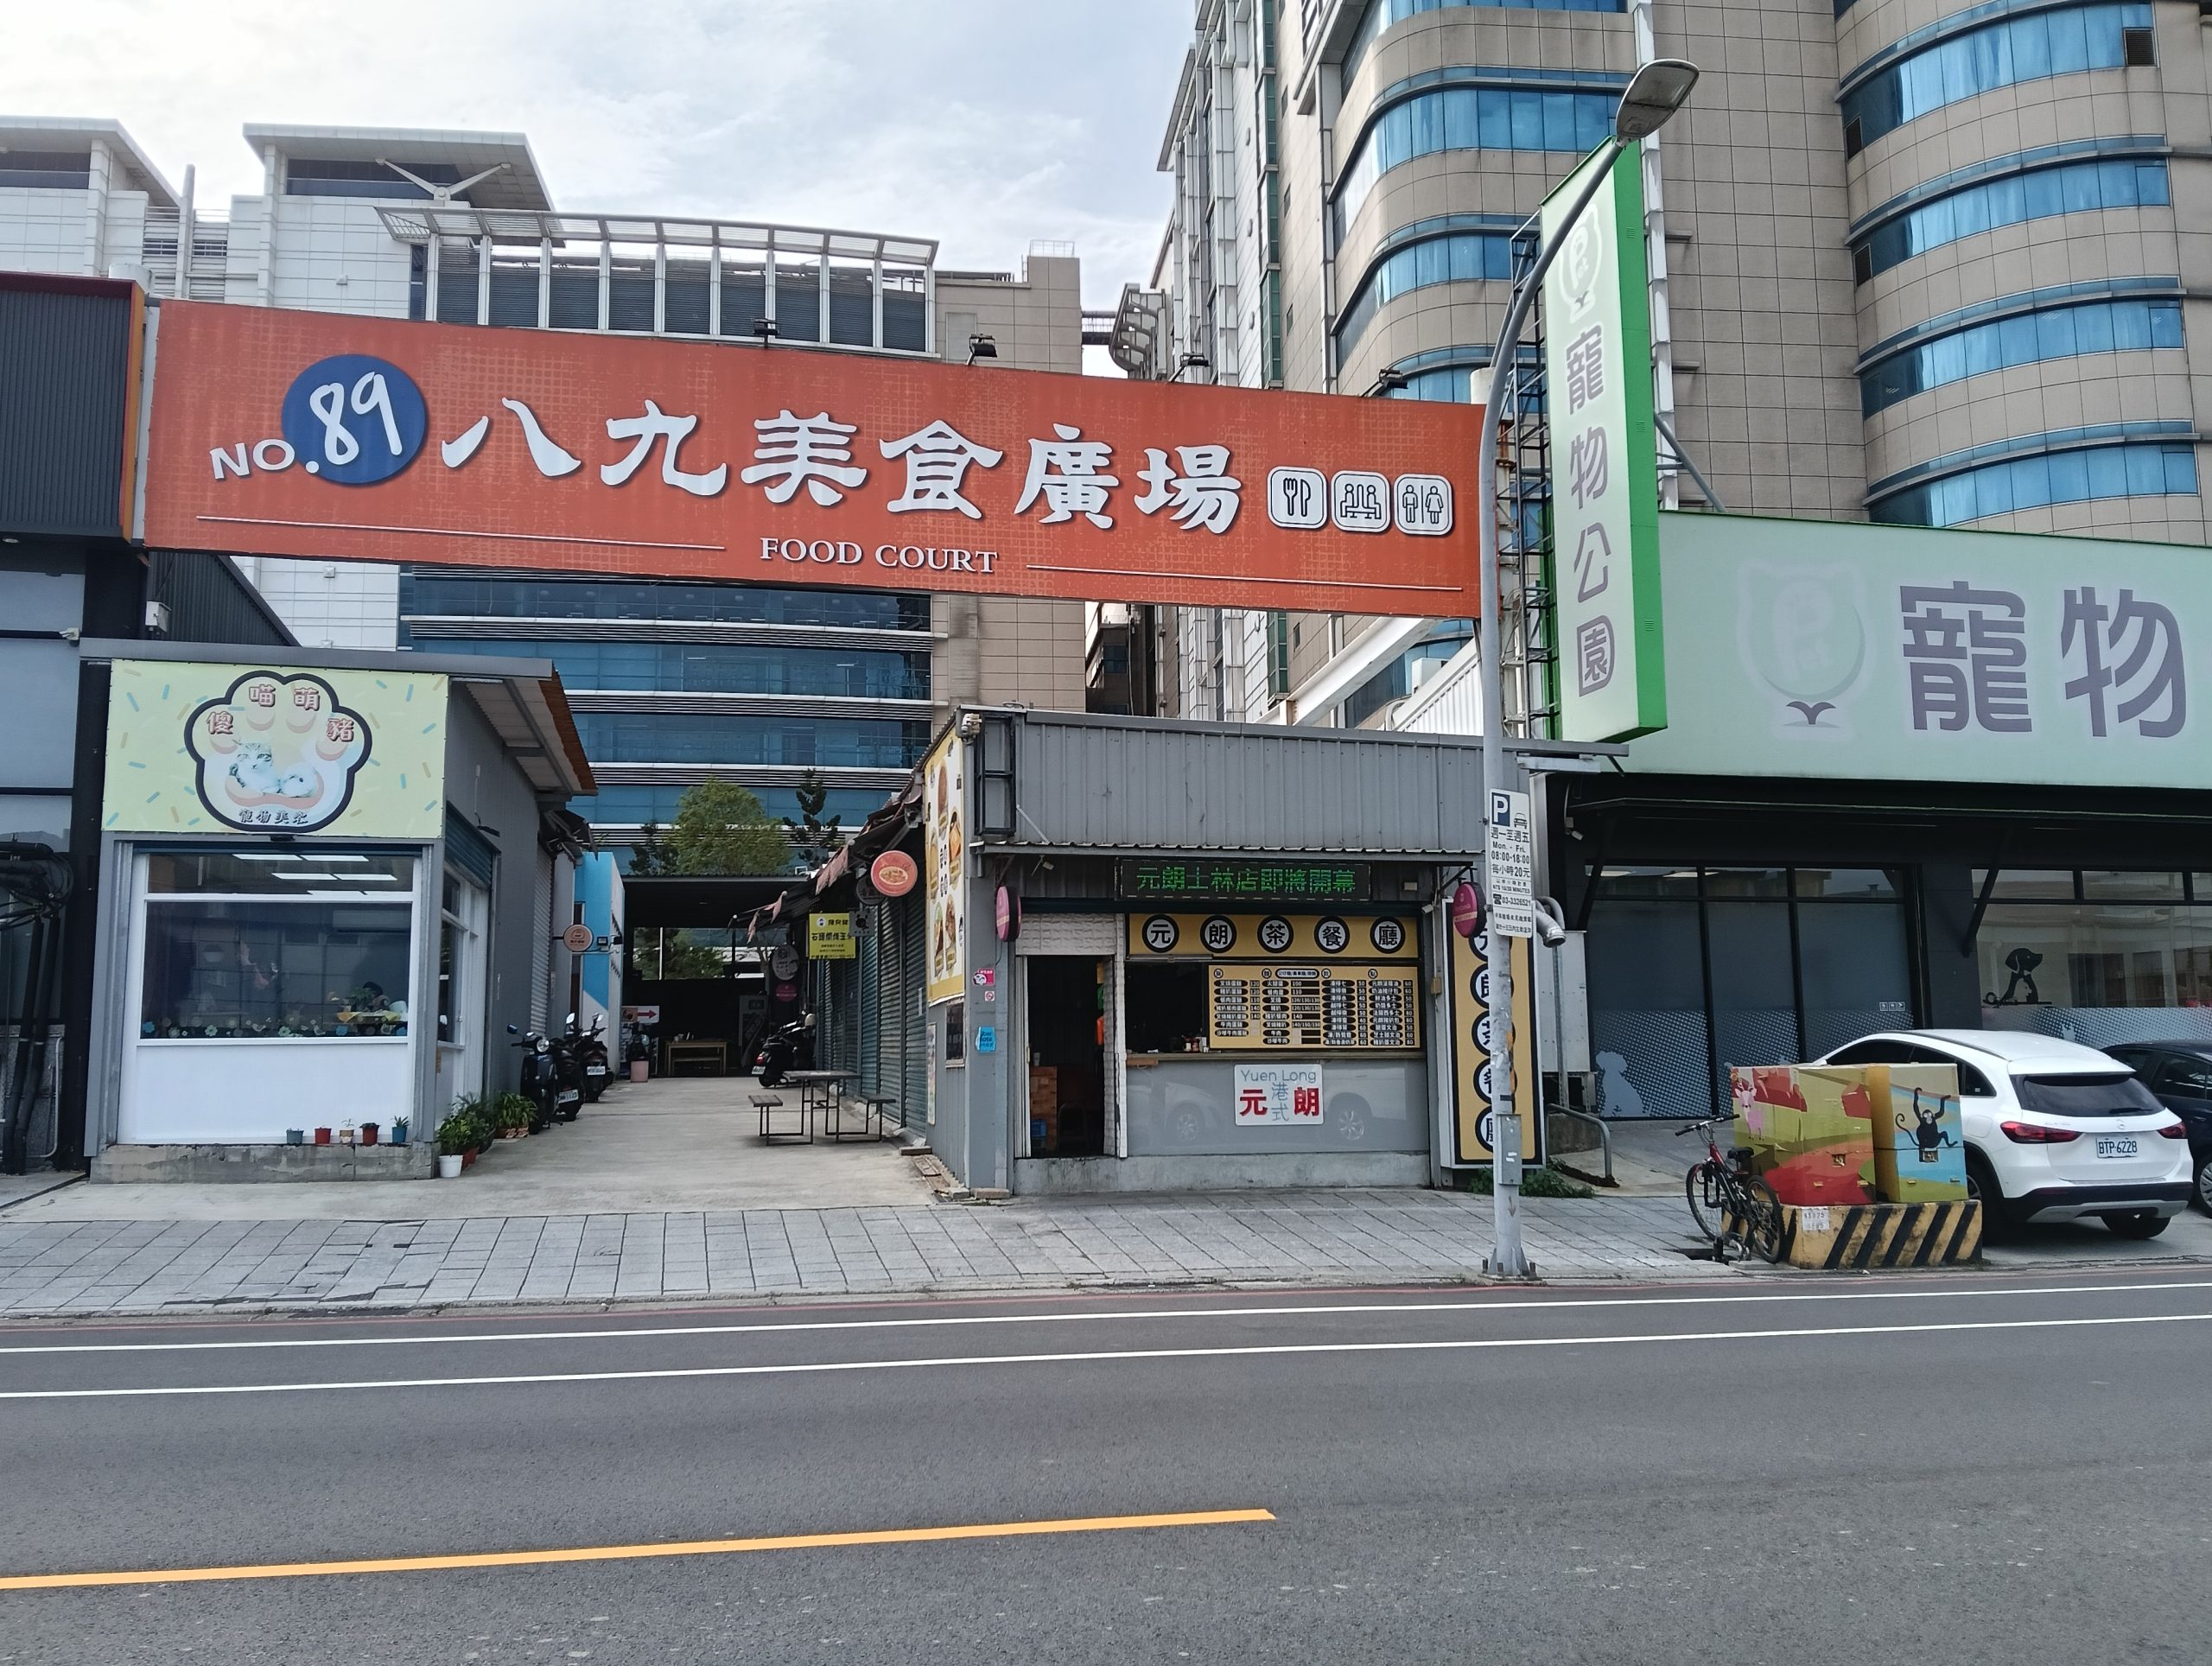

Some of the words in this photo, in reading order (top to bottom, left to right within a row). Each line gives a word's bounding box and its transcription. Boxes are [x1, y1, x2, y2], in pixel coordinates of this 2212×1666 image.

[441, 397, 1243, 535] 八九美食廣場
[1565, 323, 1615, 697] 寵物公園
[760, 537, 862, 564] FOOD
[874, 544, 999, 573] COURT
[1899, 580, 2187, 738] 寵物
[1493, 795, 1509, 823] P
[1491, 827, 1530, 843] 週一至週五
[1150, 922, 1398, 947] 元朗茶餐廳
[1240, 1069, 1277, 1082] Yuen
[1281, 1069, 1317, 1084] Long
[1271, 1082, 1289, 1122] 港式
[2098, 1141, 2138, 1154] BTP-6228
